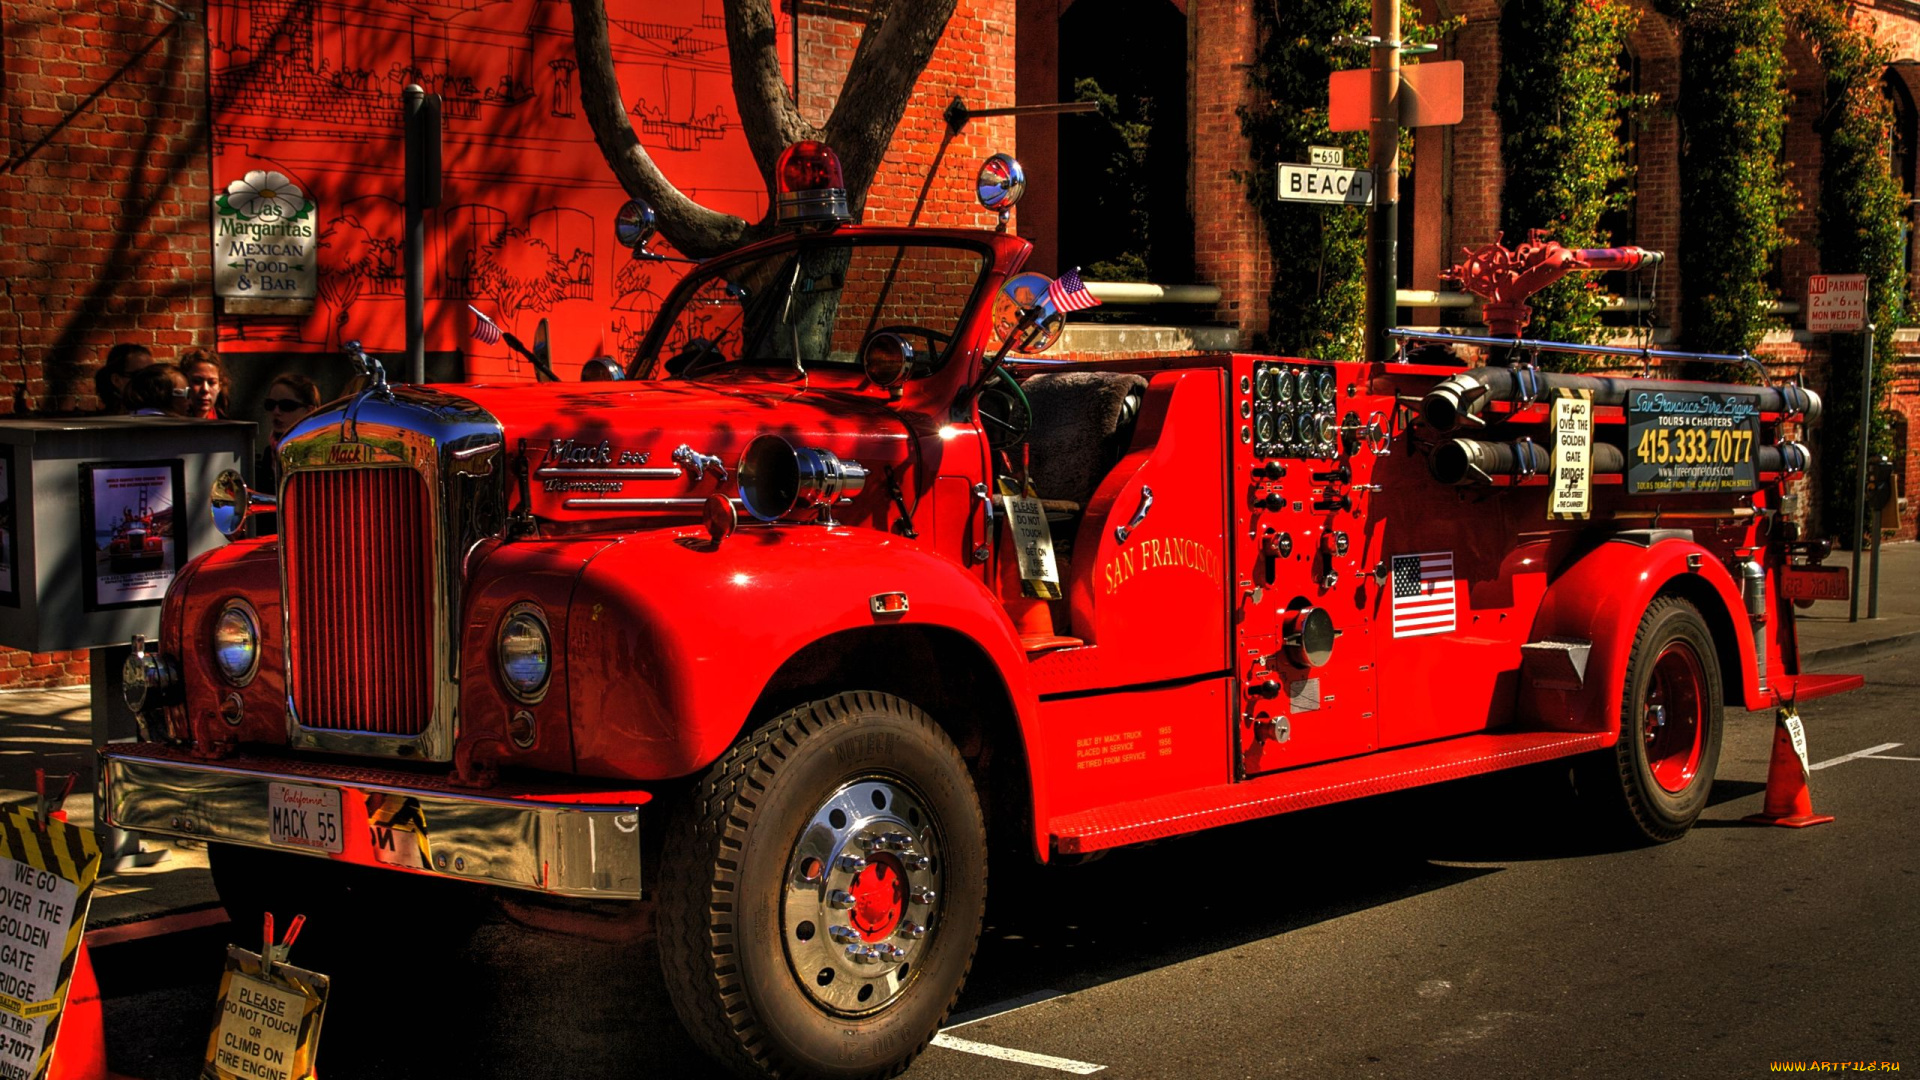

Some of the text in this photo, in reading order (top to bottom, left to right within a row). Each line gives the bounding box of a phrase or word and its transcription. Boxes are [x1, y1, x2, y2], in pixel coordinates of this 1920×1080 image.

[1321, 150, 1340, 163] 650
[1290, 172, 1363, 196] BEACH
[250, 199, 283, 216] Las
[219, 217, 312, 242] Margaritas
[237, 274, 252, 291] &
[1810, 277, 1864, 293] NO PARKING
[1813, 295, 1820, 307] 2
[1839, 295, 1846, 307] 6
[1812, 310, 1861, 320] MON WED FRI
[1562, 403, 1570, 414] WE
[1631, 393, 1760, 424] San Francisco Fire Engine
[1559, 418, 1588, 430] OVER THE
[1658, 416, 1684, 426] TOURS
[1691, 416, 1733, 427] CHARTERS
[1561, 434, 1586, 446] GOLDEN
[1637, 428, 1753, 464] 415.333.7077
[327, 444, 361, 464] Mack
[543, 438, 612, 464] Mack
[1565, 451, 1581, 463] GATE
[1560, 467, 1585, 480] BRIDGE
[1658, 464, 1734, 479] www.fireenginetours.com
[1011, 500, 1039, 513] PLEASE
[1016, 515, 1041, 526] DO NOT
[1020, 528, 1043, 538] TOUCH
[1105, 537, 1220, 595] SAN FRANCISCO
[283, 788, 328, 808] California
[273, 805, 337, 843] MACK 55
[15, 862, 57, 893] WE GO
[37, 899, 64, 925] THE
[0, 915, 50, 950] GOLDEN
[0, 944, 35, 973] GATE
[239, 987, 287, 1014] PLEASE
[11, 1016, 33, 1035] TRIP
[224, 1000, 298, 1036] DO NOT TOUCH
[248, 1026, 262, 1039] OR
[224, 1032, 284, 1065] CLIMB ON
[217, 1048, 288, 1080] FIRE ENGINE
